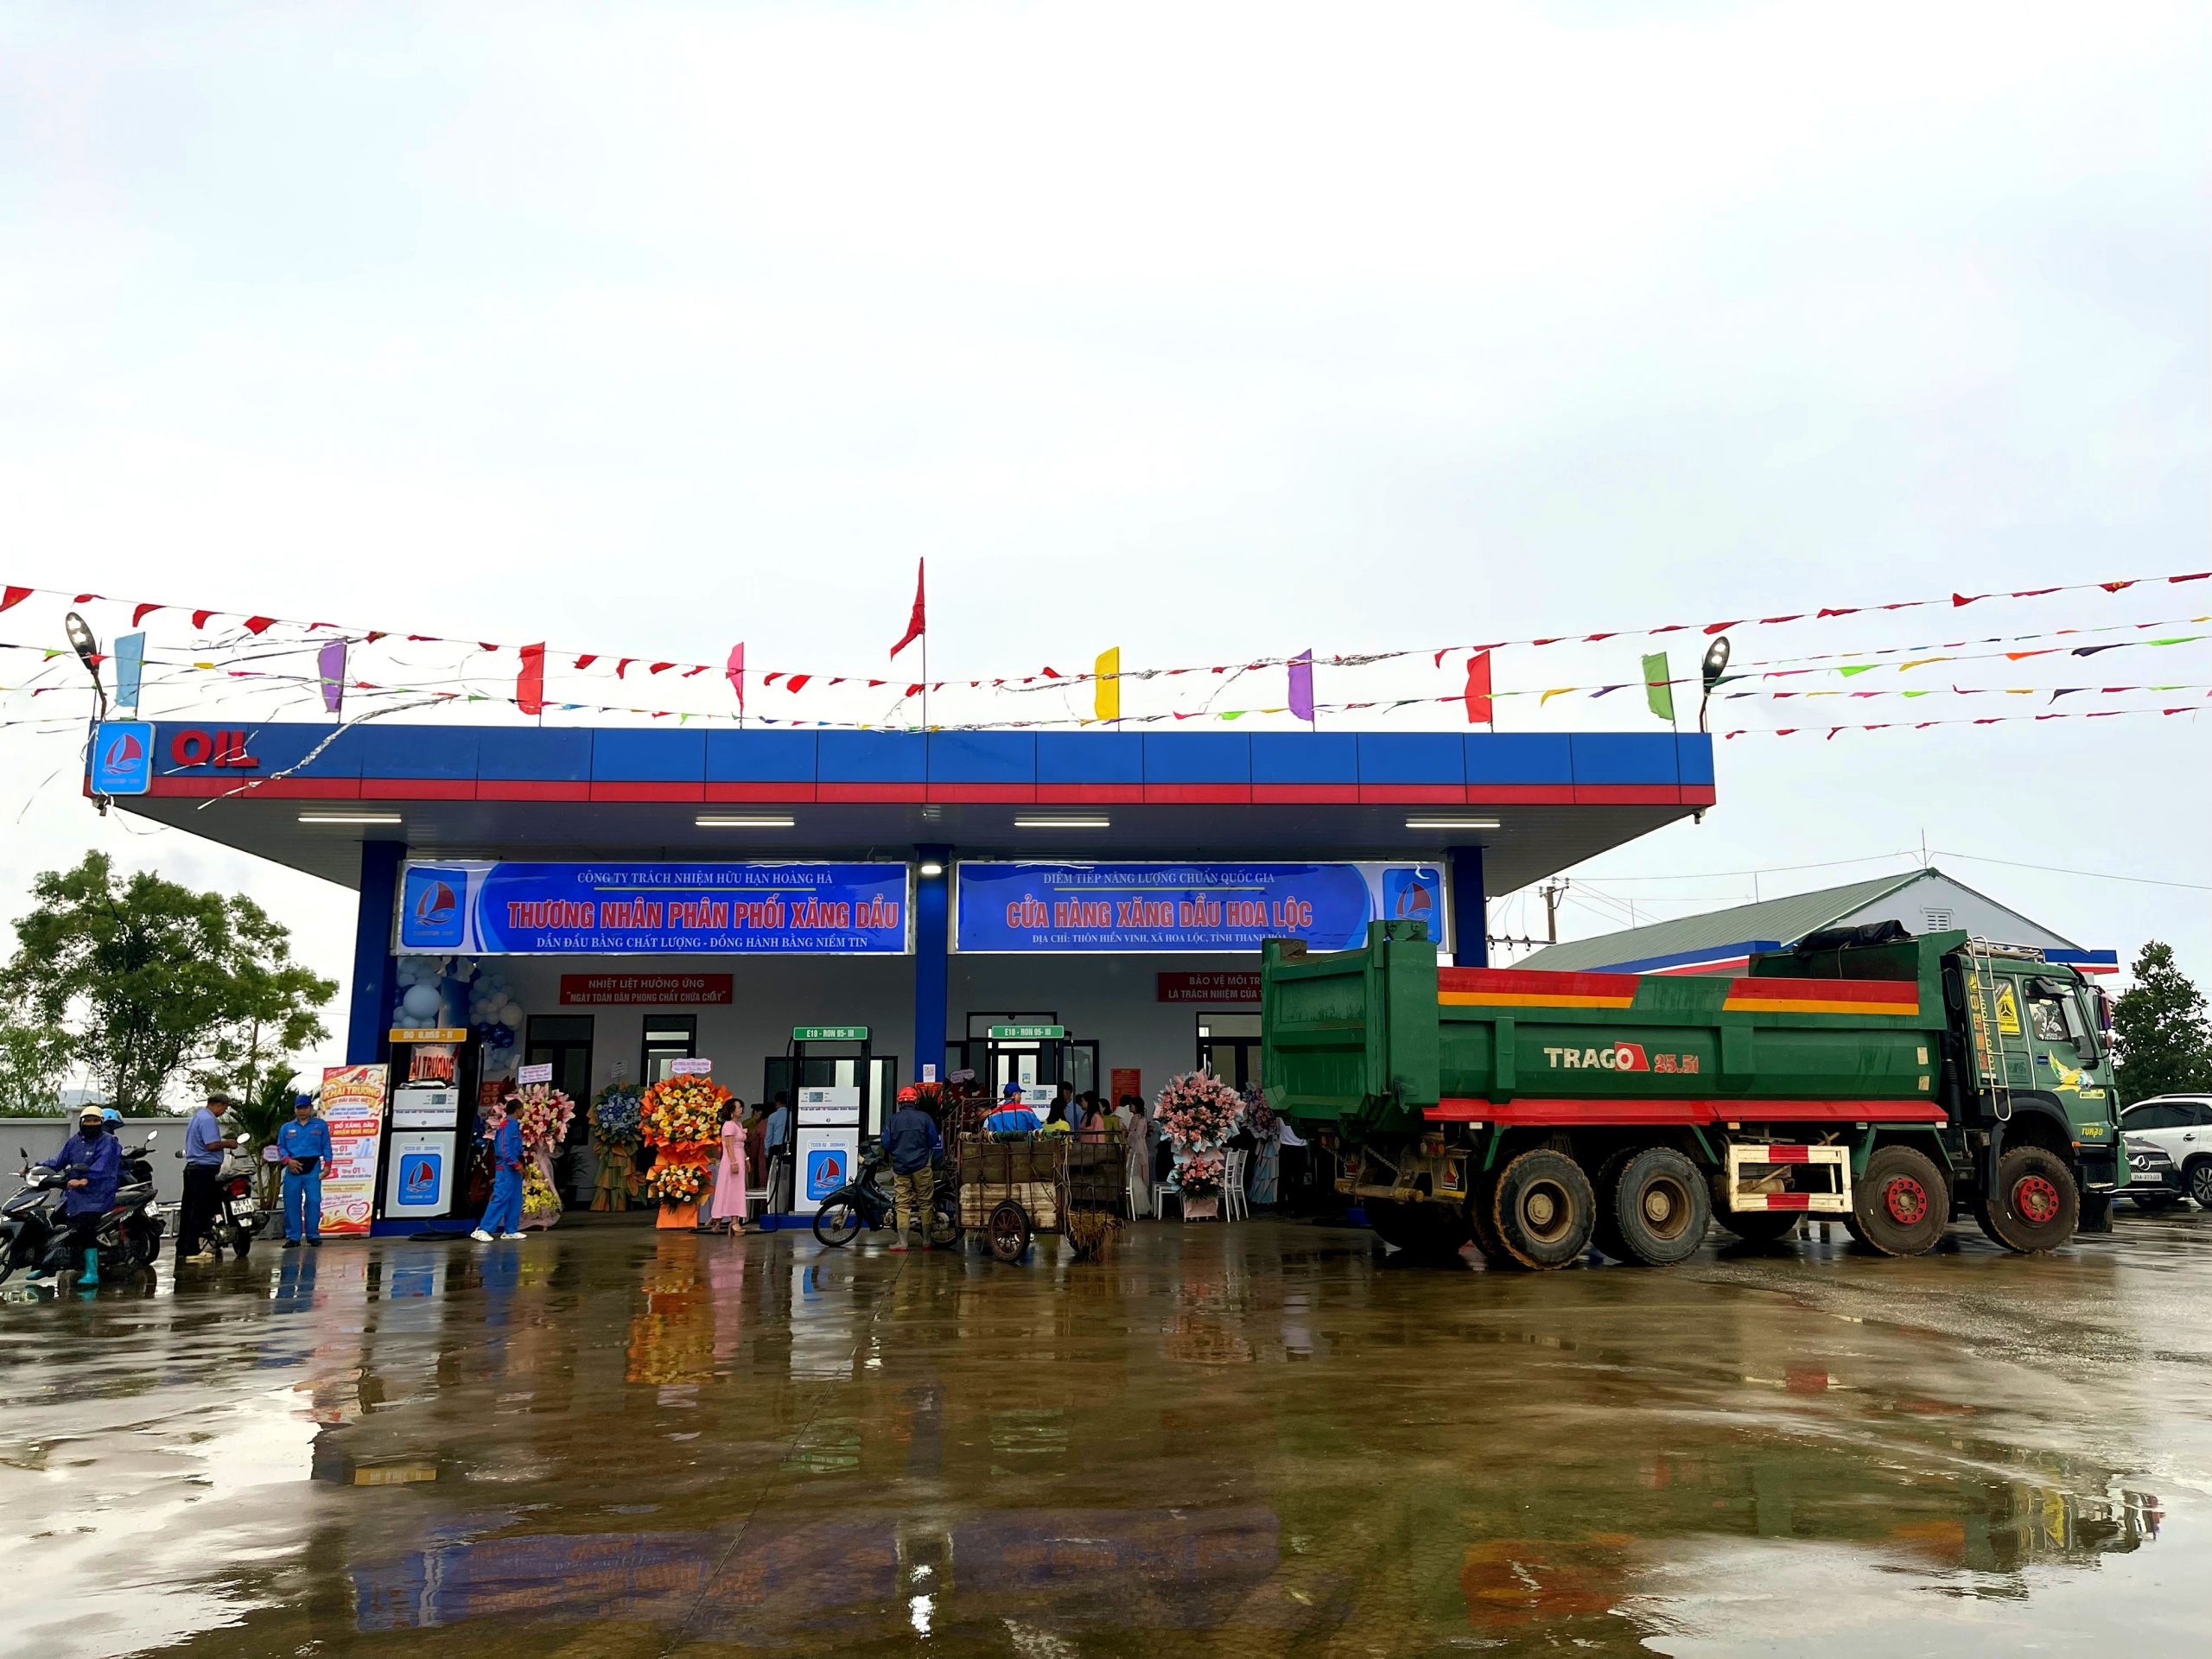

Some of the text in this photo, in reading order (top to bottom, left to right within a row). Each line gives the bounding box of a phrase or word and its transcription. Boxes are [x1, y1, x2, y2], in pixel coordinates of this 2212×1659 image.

[171, 730, 259, 766] OIL
[577, 869, 833, 887] CÔNG TY TRÁCH NHIỆM HỮU HẠN HOÀNG HÀ
[1044, 868, 1275, 886] ĐIỂM TIẾP NĂNG LƯỢNG CHUẨN QUỐC GIA
[507, 893, 899, 929] THƯƠNG NHÂN PHÂN PHỐI XĂNG DẦU
[1007, 893, 1313, 933] CỬA HÀNG XĂNG DẦU HOA LỘC
[536, 932, 562, 948] DẪN
[563, 932, 588, 948] ĐẦU
[591, 932, 623, 948] BẰNG
[626, 933, 659, 948] CHẤT
[661, 936, 701, 950] LƯỢNG
[710, 932, 743, 948] ĐỒNG
[746, 934, 779, 948] HÀNH
[782, 932, 813, 948] BẰNG
[816, 932, 846, 948] NIỀM
[848, 938, 868, 948] TIN
[1033, 934, 1048, 944] ĐỊA
[1051, 931, 1071, 943] CHỈ:
[1071, 932, 1098, 943] THÔN
[1151, 932, 1164, 943] XÃ
[1166, 934, 1185, 943] HOA
[1187, 931, 1209, 944] LỘC,
[1211, 931, 1235, 942] TỈNH
[1236, 934, 1266, 943] THANH
[588, 976, 705, 990] NHIỆT LIỆT HƯỞNG ỨNG
[1189, 974, 1211, 985] BẢO
[1213, 975, 1225, 988] VỆ
[1227, 975, 1247, 985] MÔI
[613, 991, 630, 1002] DÂN
[658, 989, 678, 1002] CHÁY
[1168, 988, 1179, 999] LÀ
[1180, 988, 1208, 999] TRÁCH
[1210, 988, 1237, 1001] NHIỆM
[1240, 988, 1258, 999] CỦA
[806, 1029, 818, 1038] E10
[823, 1029, 836, 1038] RON
[1004, 1027, 1016, 1036] E10
[1020, 1027, 1033, 1036] RON
[1543, 1046, 1634, 1071] TRAGO
[323, 1085, 380, 1099] KHAI TRƯƠNG
[2082, 1128, 2104, 1138] TURBO
